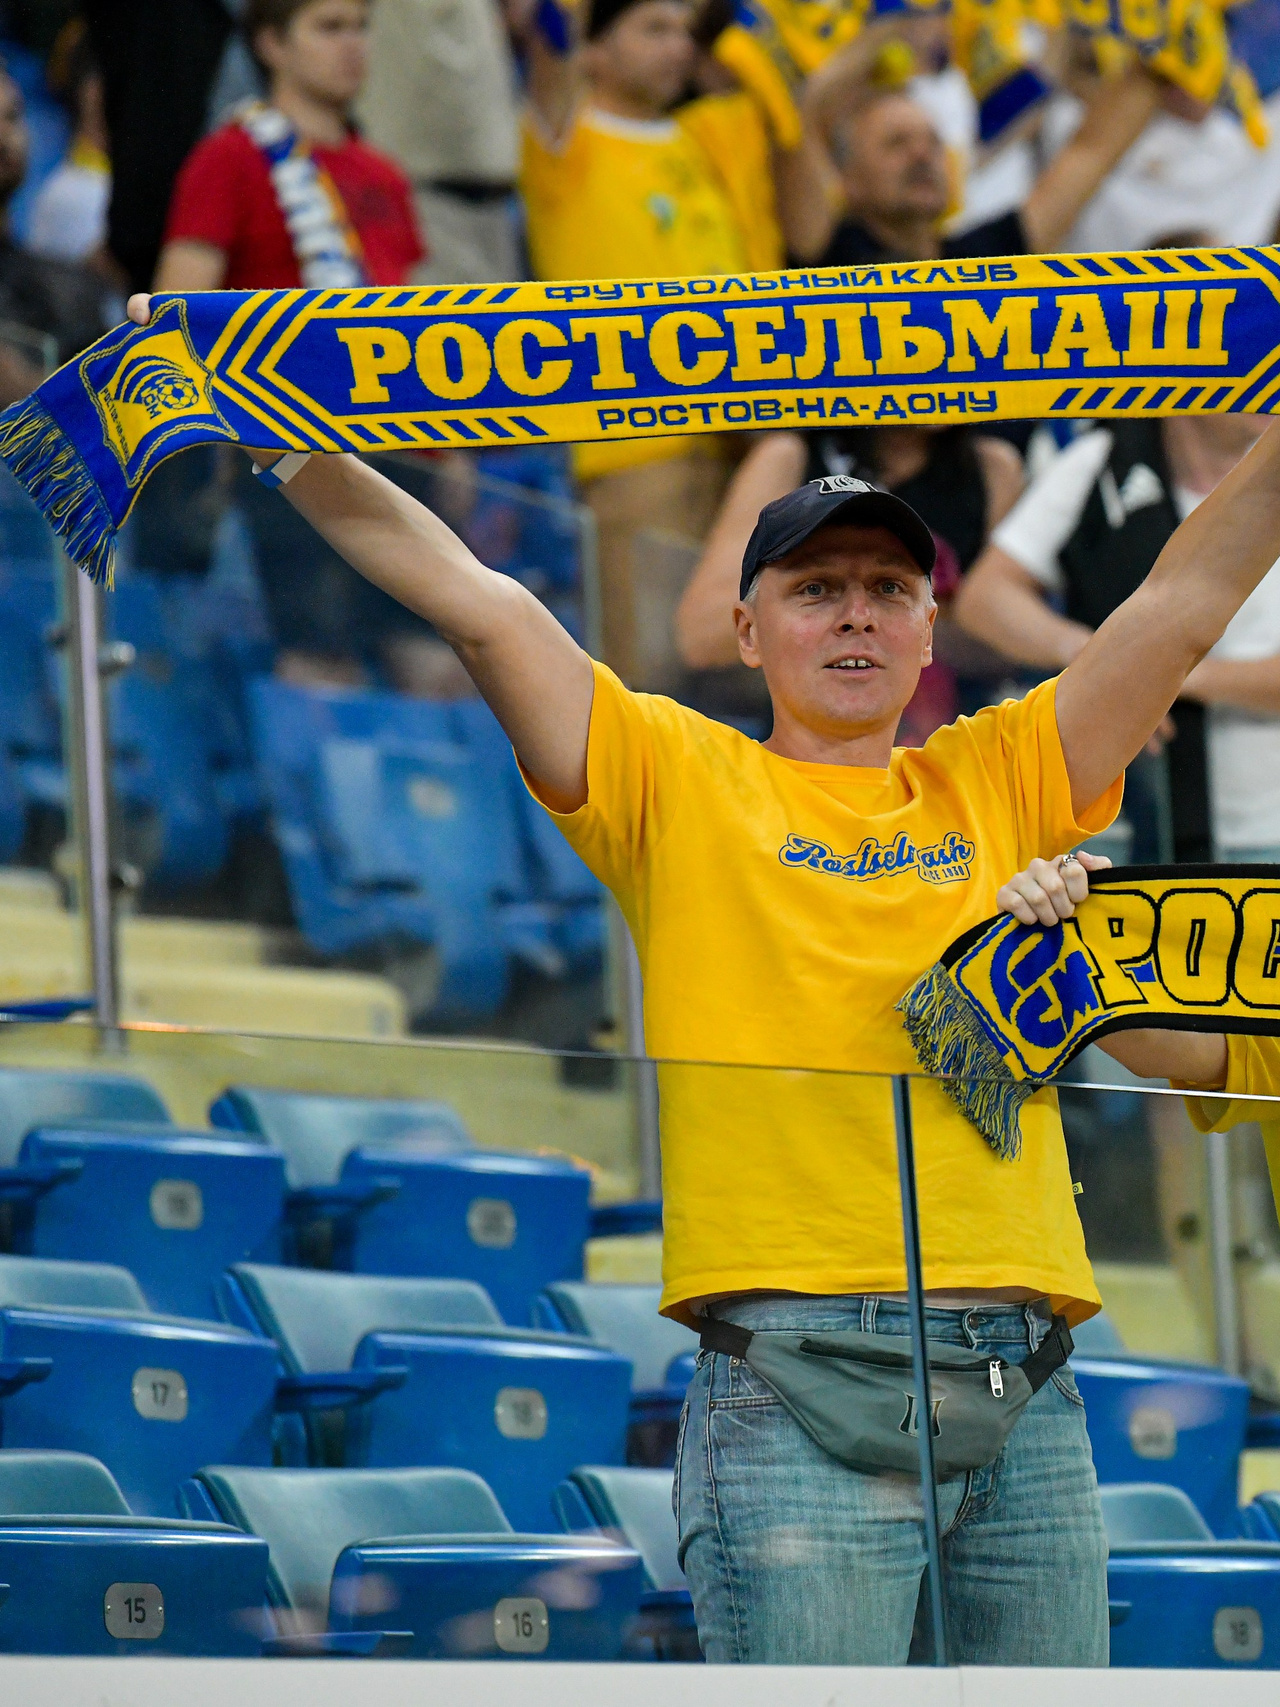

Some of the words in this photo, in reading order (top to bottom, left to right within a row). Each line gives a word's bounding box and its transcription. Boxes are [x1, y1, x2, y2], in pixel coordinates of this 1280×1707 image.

[544, 266, 882, 302] ФУТБОЛЬНЫЙ
[891, 263, 1018, 287] КЛУБ
[337, 287, 1237, 404] РОСТСЕЛЬМАШ
[597, 390, 998, 430] РОСТОВ-НА-ДОНУ
[151, 1381, 169, 1406] 17
[123, 1597, 147, 1623] 15
[512, 1611, 533, 1637] 16
